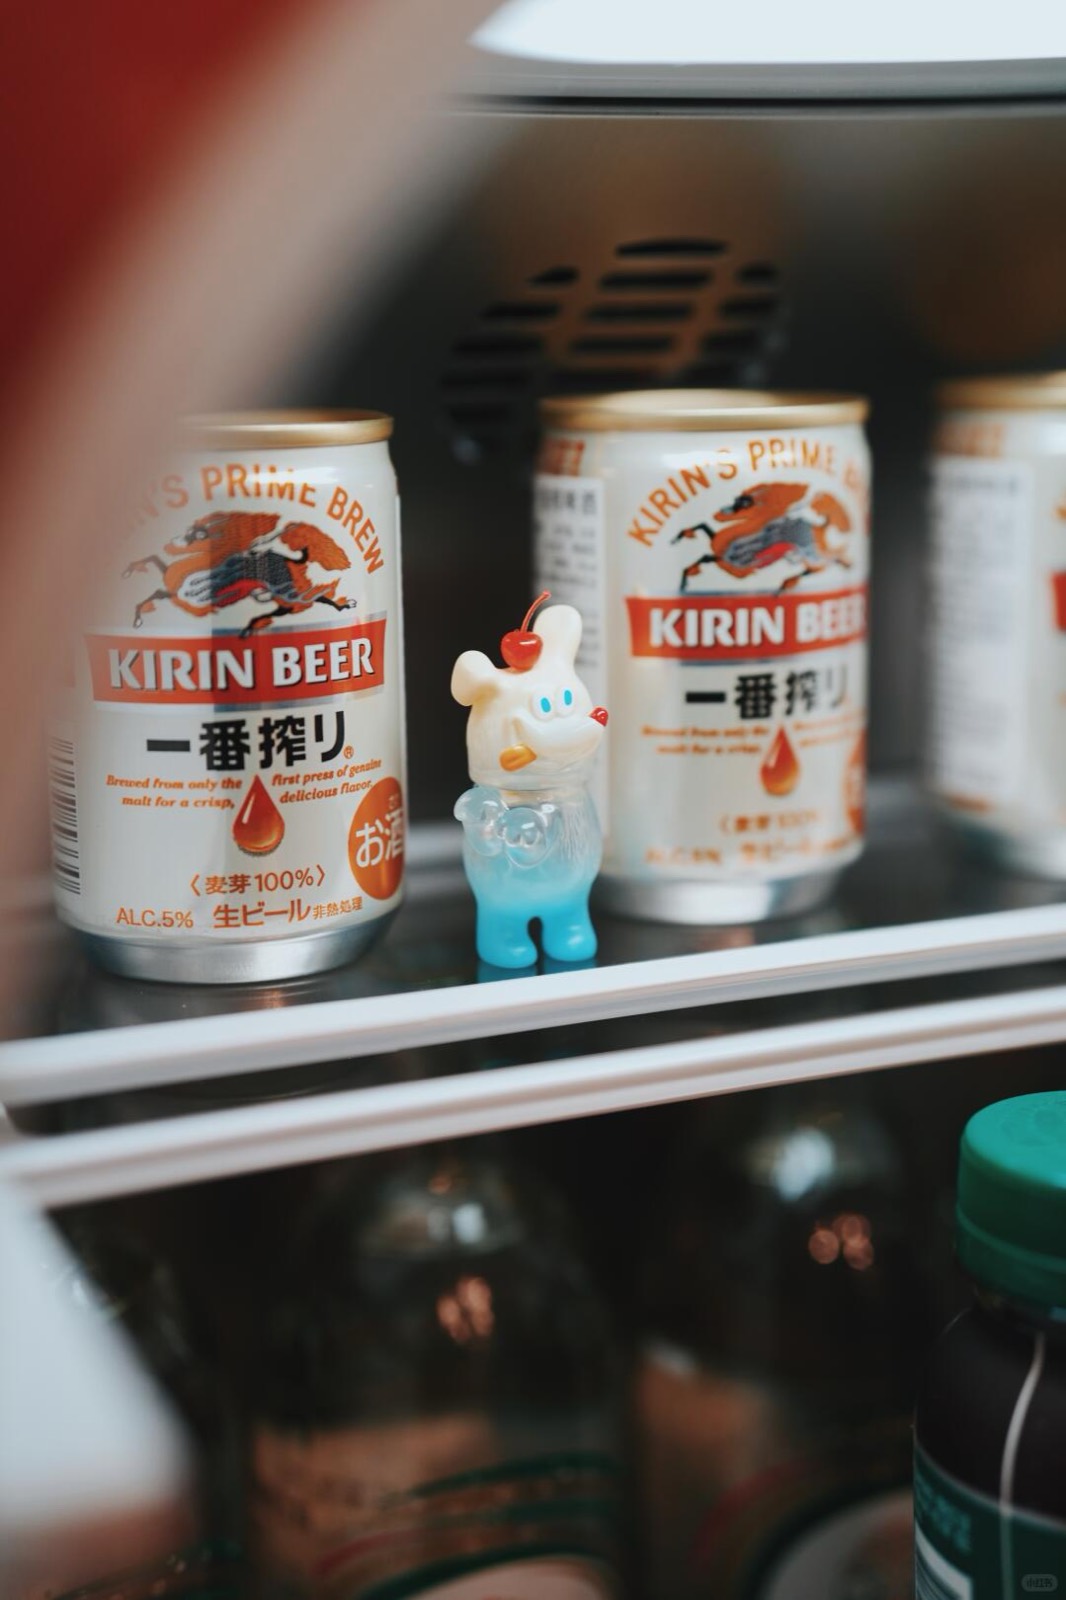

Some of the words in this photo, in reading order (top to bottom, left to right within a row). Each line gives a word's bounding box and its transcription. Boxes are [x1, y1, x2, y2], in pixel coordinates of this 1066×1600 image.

[201, 463, 316, 508] PRIME
[326, 485, 384, 574] BREW
[650, 605, 785, 648] KIRIN
[107, 648, 256, 692] KIRIN
[271, 637, 375, 688] BEER
[146, 711, 346, 771] 一番搾り
[106, 774, 150, 789] Brewed
[153, 778, 184, 790] from
[188, 778, 218, 792] only
[221, 776, 243, 790] the
[272, 772, 300, 787] first
[302, 769, 335, 786] press
[336, 764, 349, 778] of
[348, 758, 382, 778] genuine
[122, 795, 151, 807] malt
[154, 795, 176, 807] for
[180, 799, 189, 808] a
[193, 797, 235, 810] crisp,
[279, 786, 338, 805] delicious
[116, 907, 194, 929] ALC.5%
